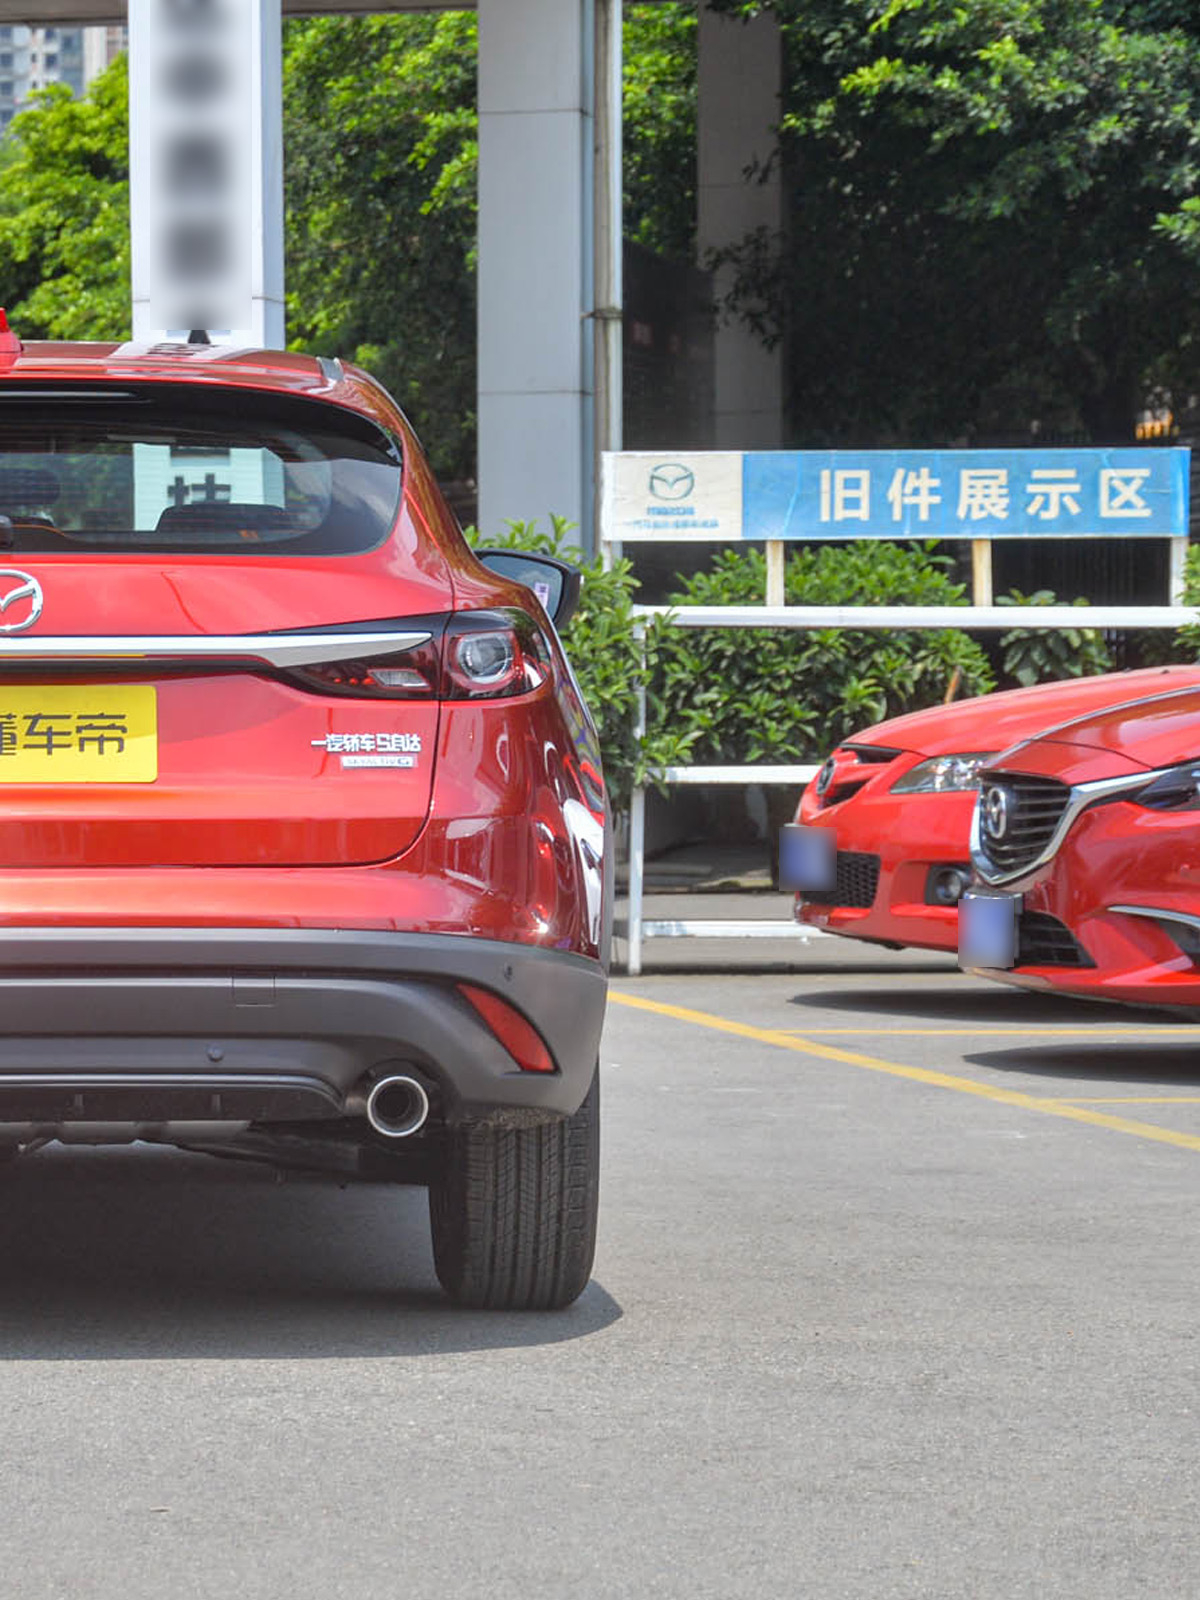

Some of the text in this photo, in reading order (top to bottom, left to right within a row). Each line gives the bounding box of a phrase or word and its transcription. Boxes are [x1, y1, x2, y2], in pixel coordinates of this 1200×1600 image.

[819, 468, 1152, 521] 旧件展示区
